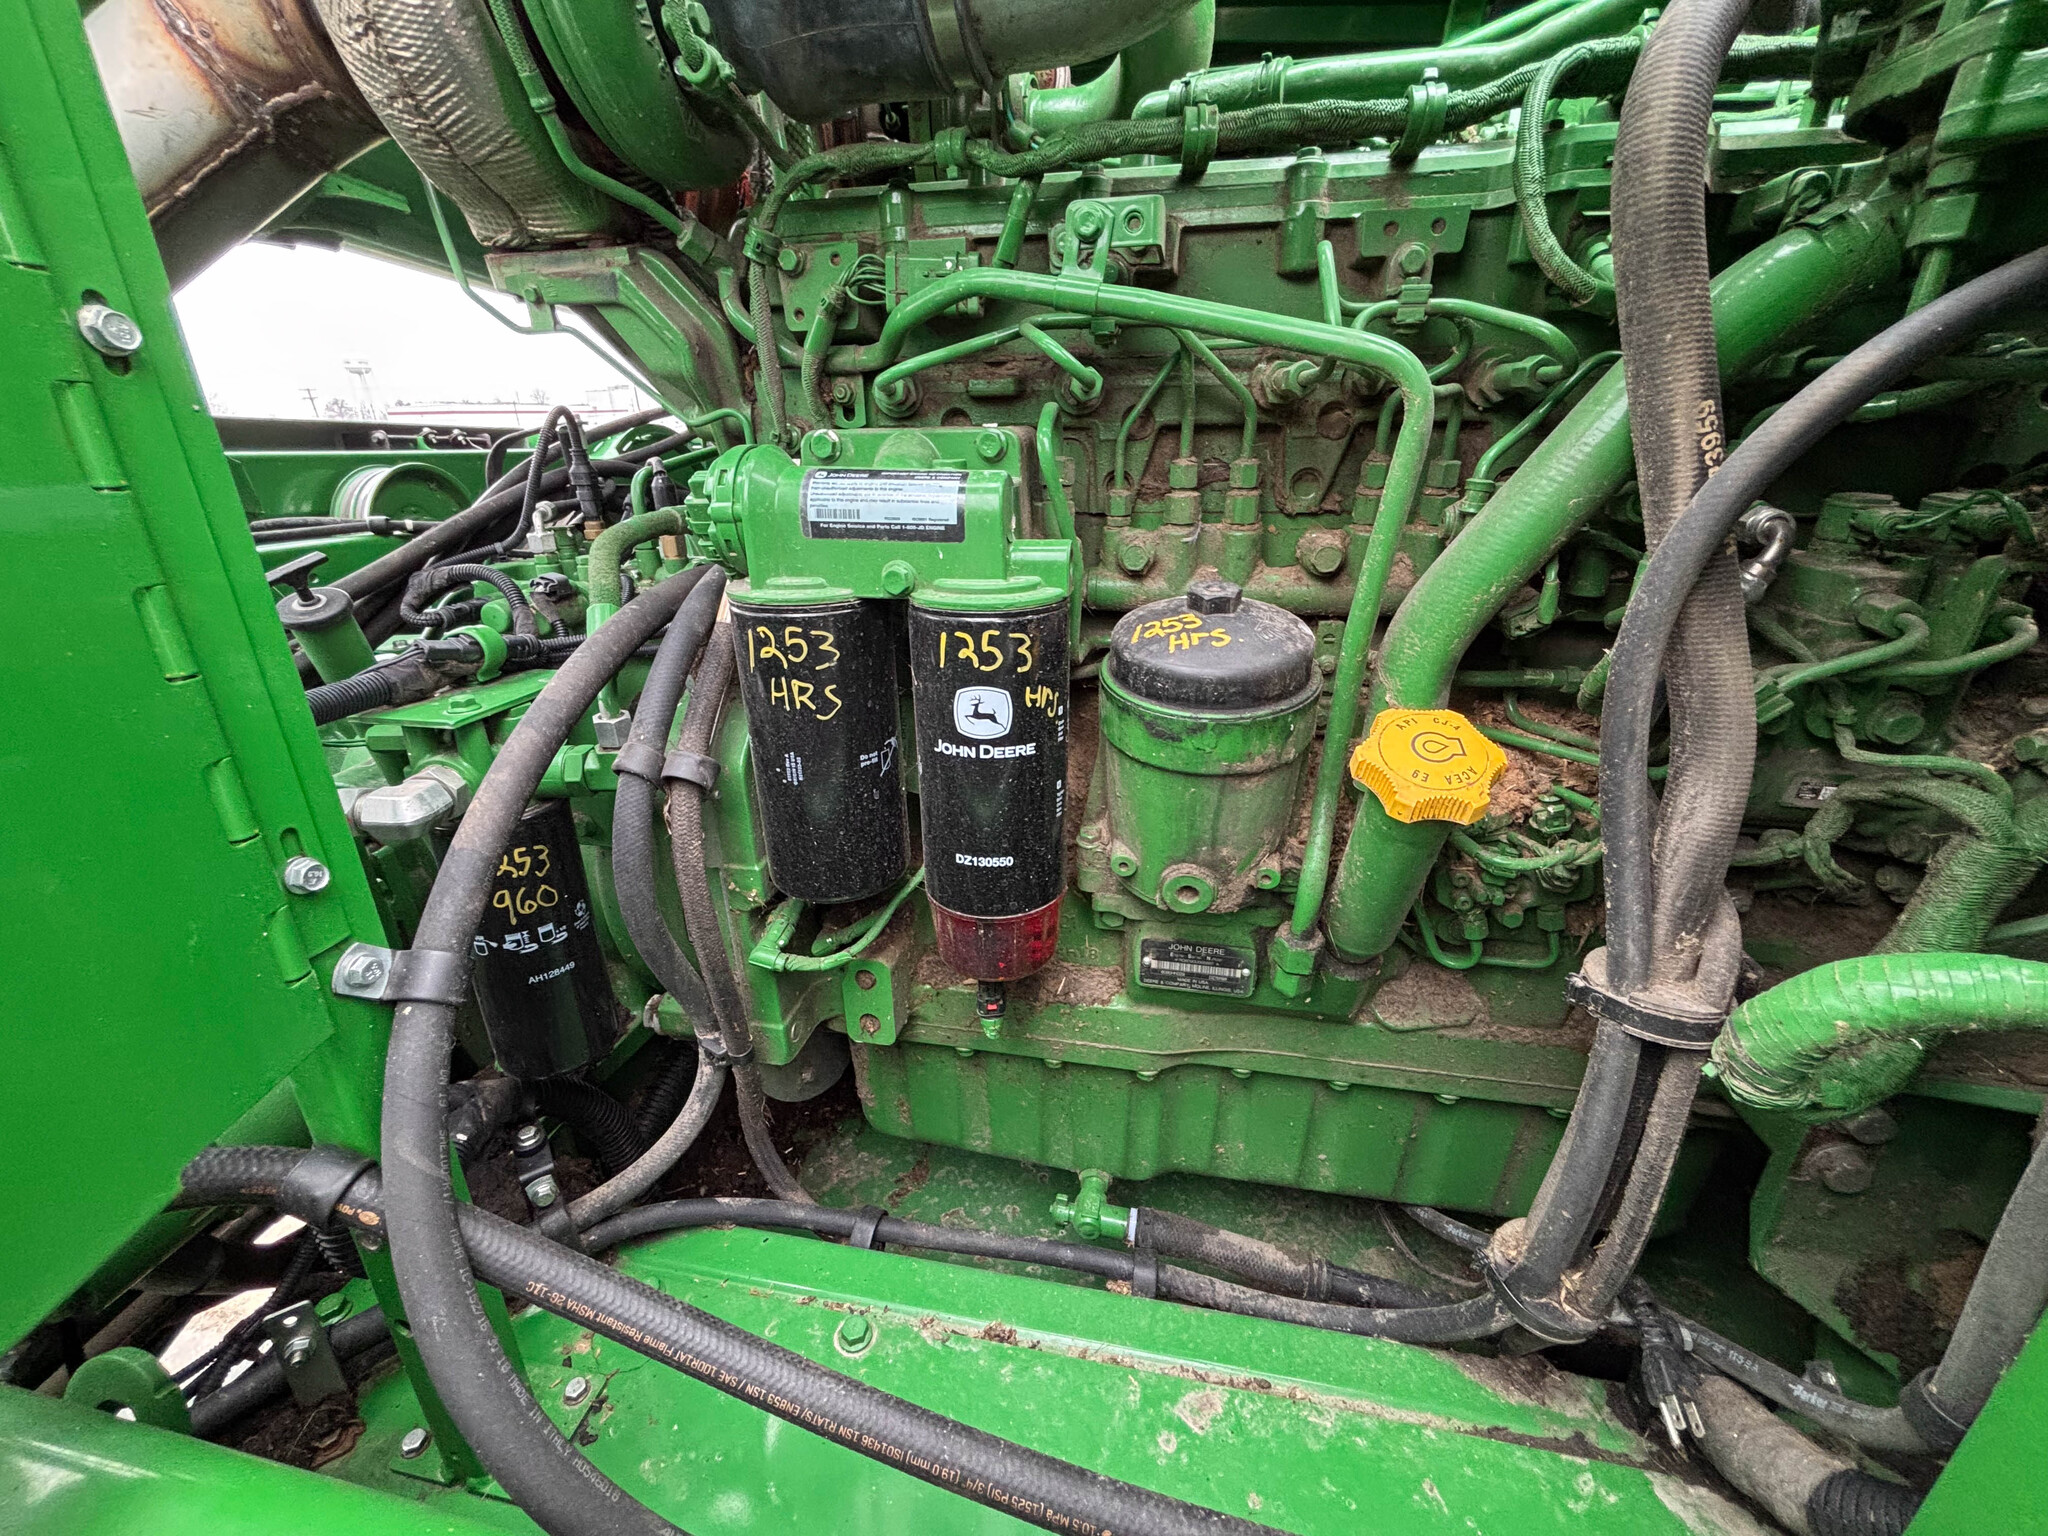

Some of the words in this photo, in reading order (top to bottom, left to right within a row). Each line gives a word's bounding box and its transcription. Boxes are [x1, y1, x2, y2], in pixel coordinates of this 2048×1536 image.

[1131, 613, 1202, 644] 1253
[748, 626, 840, 673] 1253
[939, 630, 1032, 673] 1253
[1395, 717, 1418, 731] API
[1433, 717, 1461, 731] CJ-4
[934, 739, 976, 758] JOHN
[979, 742, 1036, 759] DEERE
[1444, 766, 1478, 785] ACEA
[955, 853, 1014, 867] DZ130550
[1168, 943, 1193, 952] JOHN
[1195, 946, 1225, 955] DEERE
[528, 961, 575, 984] AH128449
[565, 1297, 596, 1320] MSHA
[596, 1312, 643, 1343] Resistant
[642, 1334, 674, 1358] Flame
[673, 1348, 718, 1378] 100R1AT
[716, 1369, 738, 1387] SAE
[744, 1382, 766, 1400] 1SN
[765, 1391, 800, 1415] EN853
[507, 1373, 532, 1407] MADE
[528, 1405, 545, 1424] IN
[543, 1423, 573, 1457] ITALY
[836, 1423, 860, 1442] 1SN
[859, 1433, 905, 1460] ISO1436
